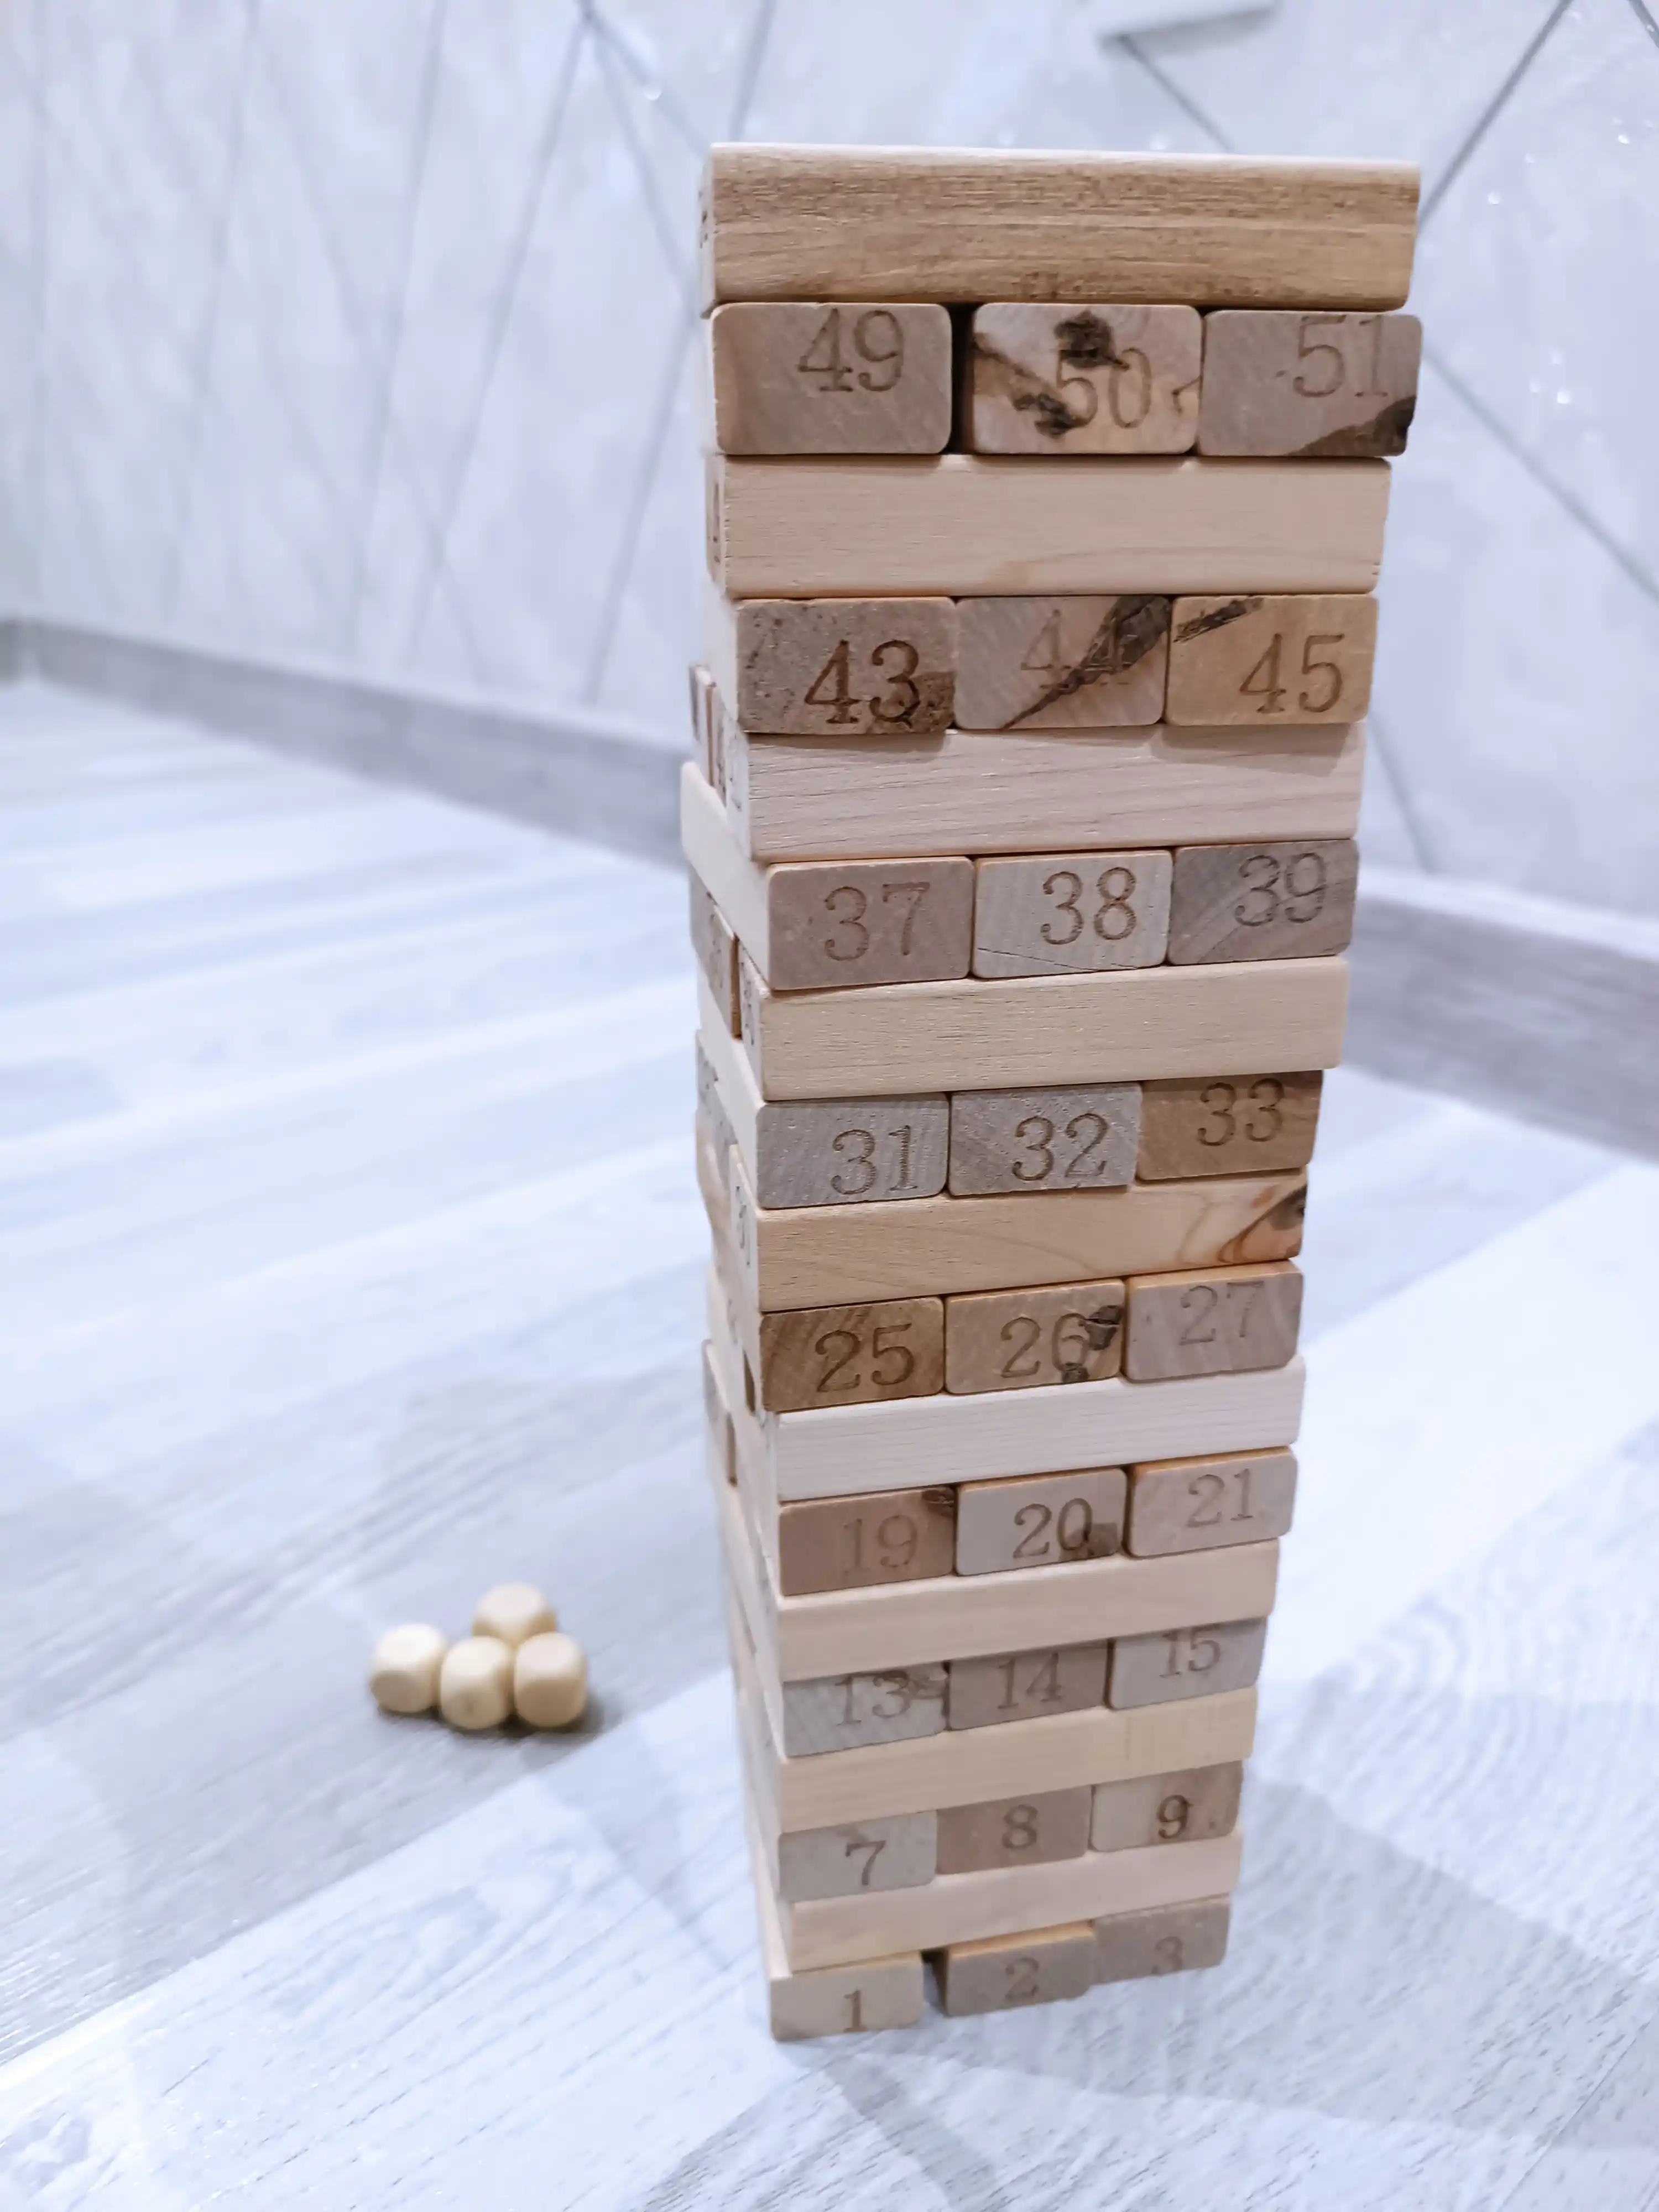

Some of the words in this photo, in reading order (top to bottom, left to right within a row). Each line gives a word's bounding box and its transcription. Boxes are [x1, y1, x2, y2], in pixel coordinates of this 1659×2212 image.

[797, 307, 906, 393] 49
[1292, 314, 1389, 399] 51
[1054, 348, 1152, 430] 50
[804, 638, 920, 724] 43
[1239, 632, 1346, 713] 45
[823, 881, 930, 962] 37
[1040, 866, 1136, 945] 38
[1235, 852, 1327, 927] 39
[1197, 1077, 1285, 1146] 33
[831, 1124, 917, 1195] 31
[1011, 1113, 1109, 1181] 32
[1000, 1312, 1089, 1379] 26
[1180, 1281, 1264, 1346] 27
[815, 1322, 915, 1393] 25
[1013, 1498, 1093, 1559] 20
[1187, 1468, 1255, 1528] 21
[843, 1514, 918, 1575] 19
[998, 1652, 1062, 1710] 14
[1159, 1626, 1221, 1678] 15
[836, 1670, 910, 1726] 13
[1001, 1804, 1037, 1849] 8
[1157, 1794, 1193, 1839] 9
[845, 1840, 886, 1886] 7
[1006, 1957, 1039, 2000] 2
[1154, 1936, 1183, 1975] 3
[843, 1989, 867, 2032] 1
